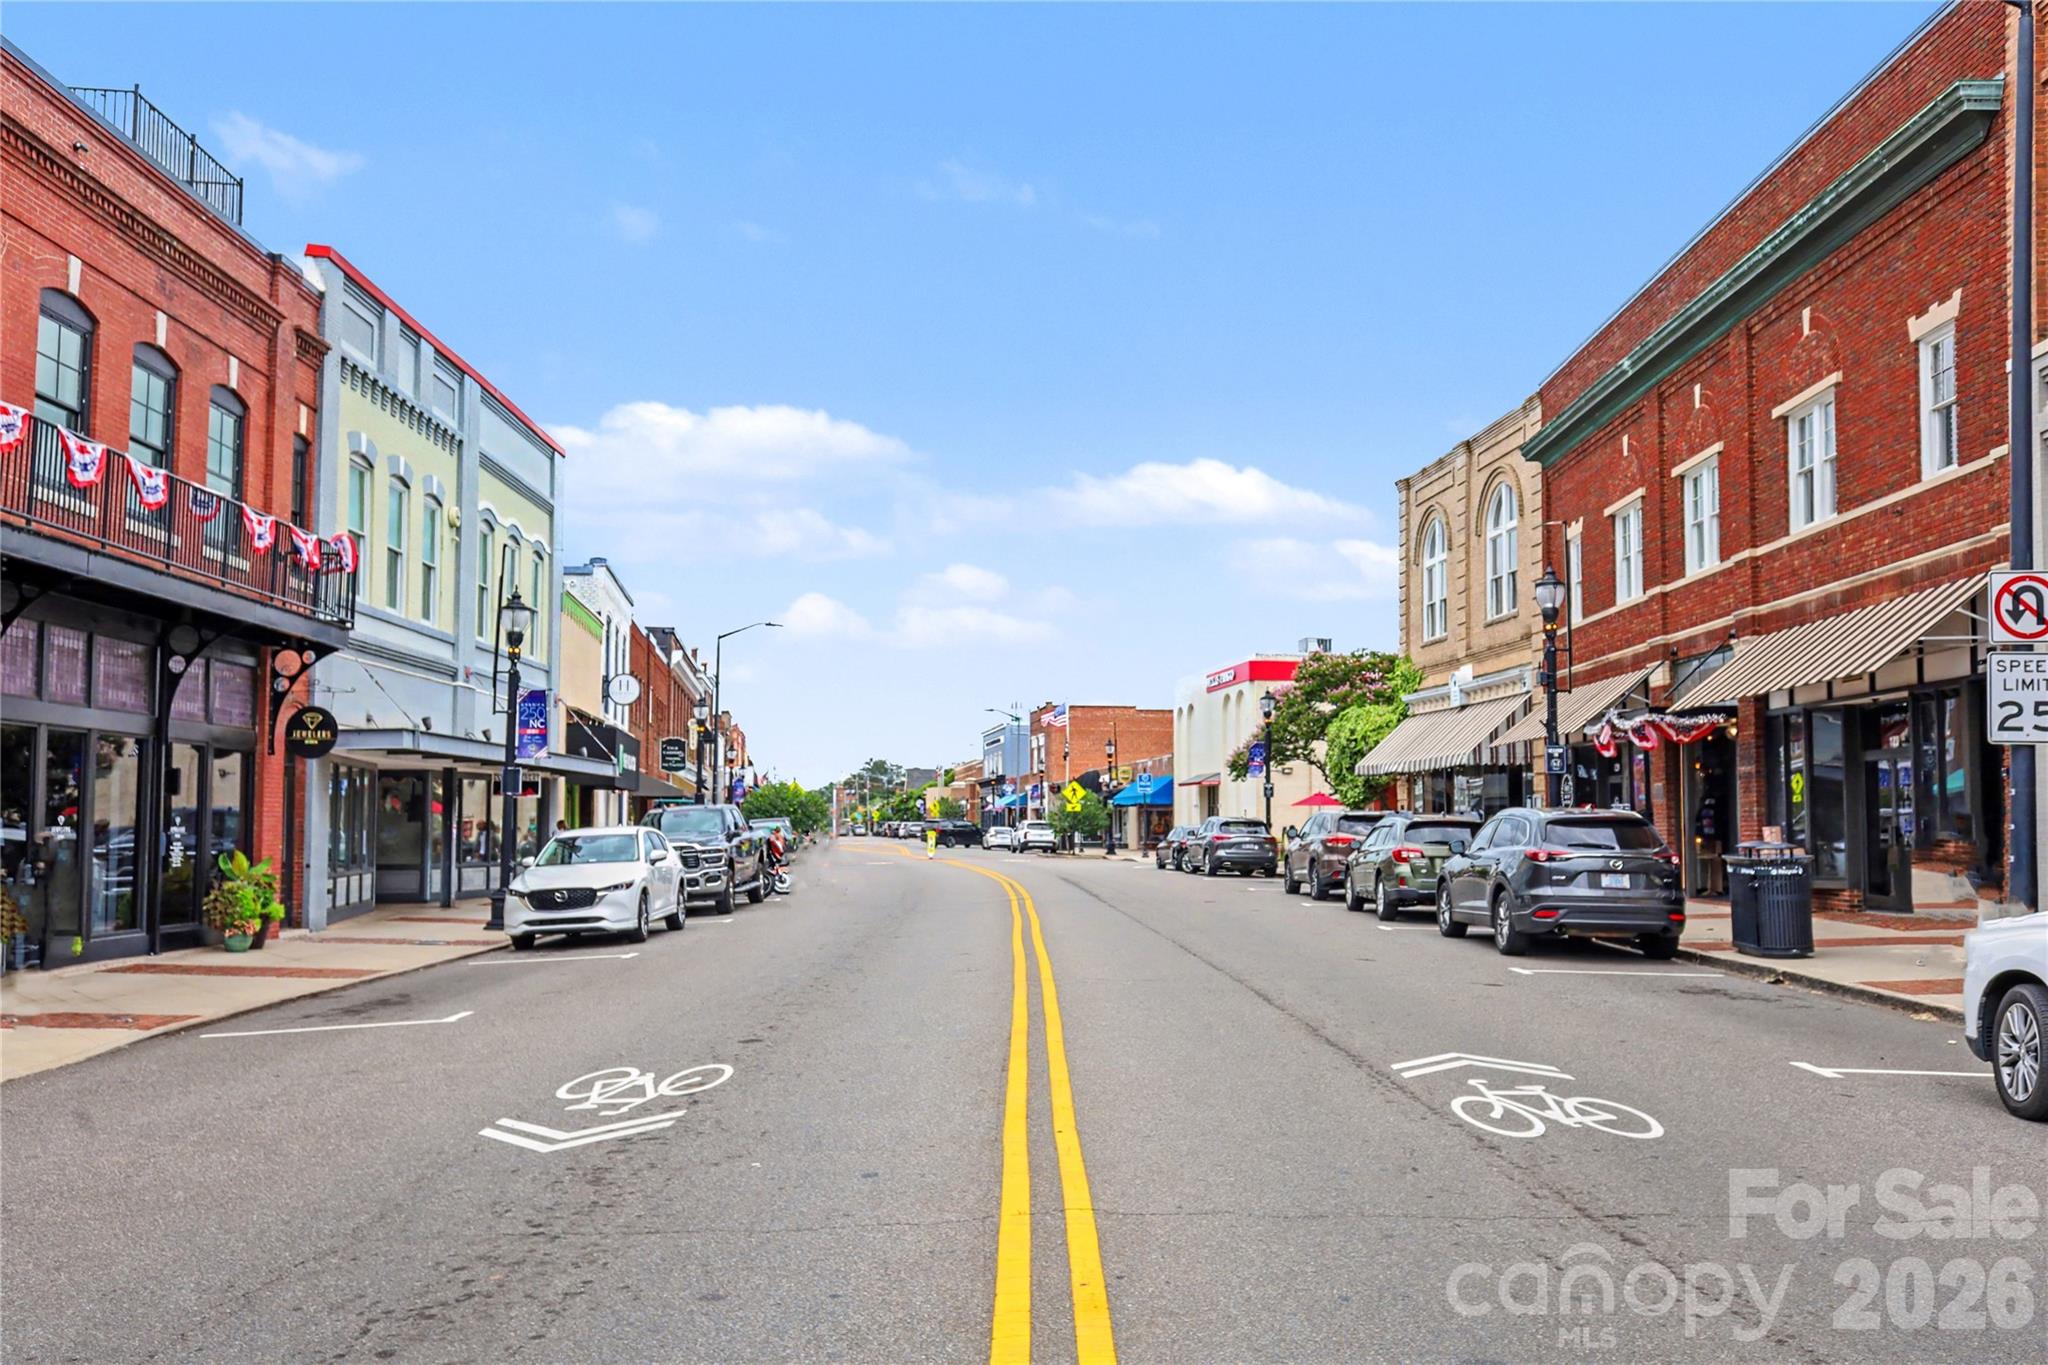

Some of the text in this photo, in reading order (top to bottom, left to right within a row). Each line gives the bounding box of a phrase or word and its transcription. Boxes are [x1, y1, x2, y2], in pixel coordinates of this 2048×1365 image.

[1996, 660, 2048, 673] SPEE
[520, 706, 546, 720] 250
[1997, 700, 2048, 732] 25
[529, 719, 546, 729] NC
